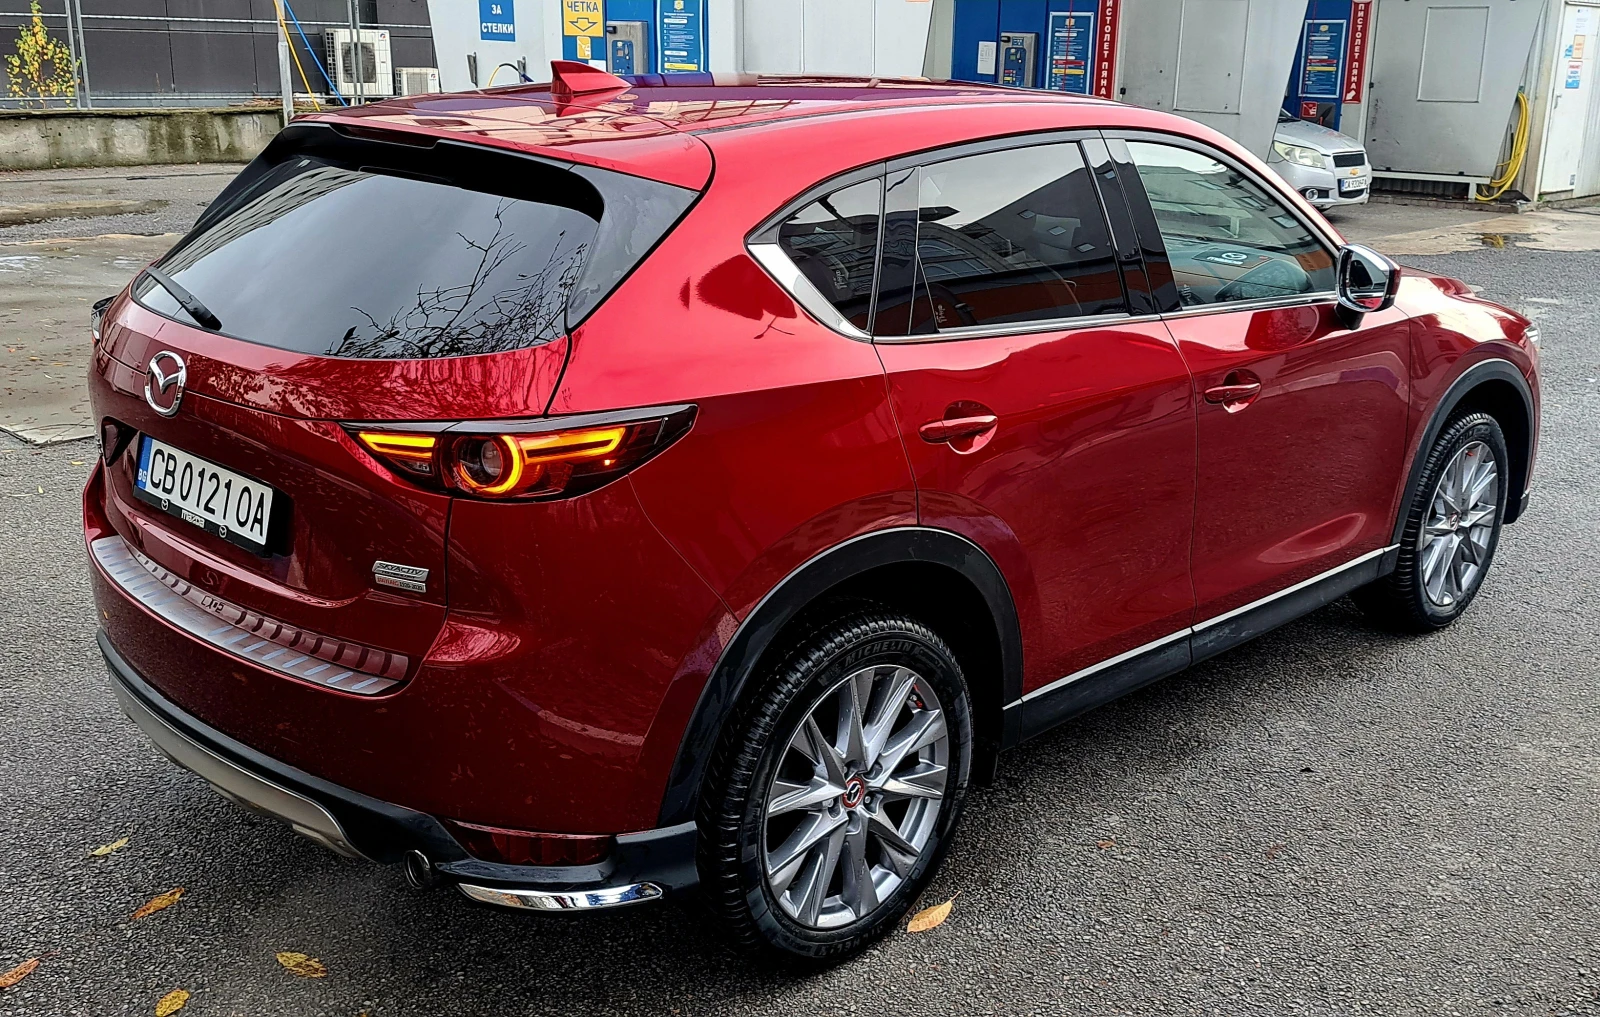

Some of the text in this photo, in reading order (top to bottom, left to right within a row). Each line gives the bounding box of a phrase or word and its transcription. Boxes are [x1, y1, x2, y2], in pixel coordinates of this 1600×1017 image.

[491, 4, 502, 15] ЗА
[566, 0, 600, 13] ЧЕТКА
[481, 23, 514, 34] СТЕЛКИ
[1350, 4, 1365, 90] ПИСТОЛЕТ ПЯНА
[1100, 62, 1109, 95] ПЯНА
[137, 468, 148, 483] BG
[377, 562, 423, 576] SKYACTIV
[844, 641, 912, 666] MICHELIN
